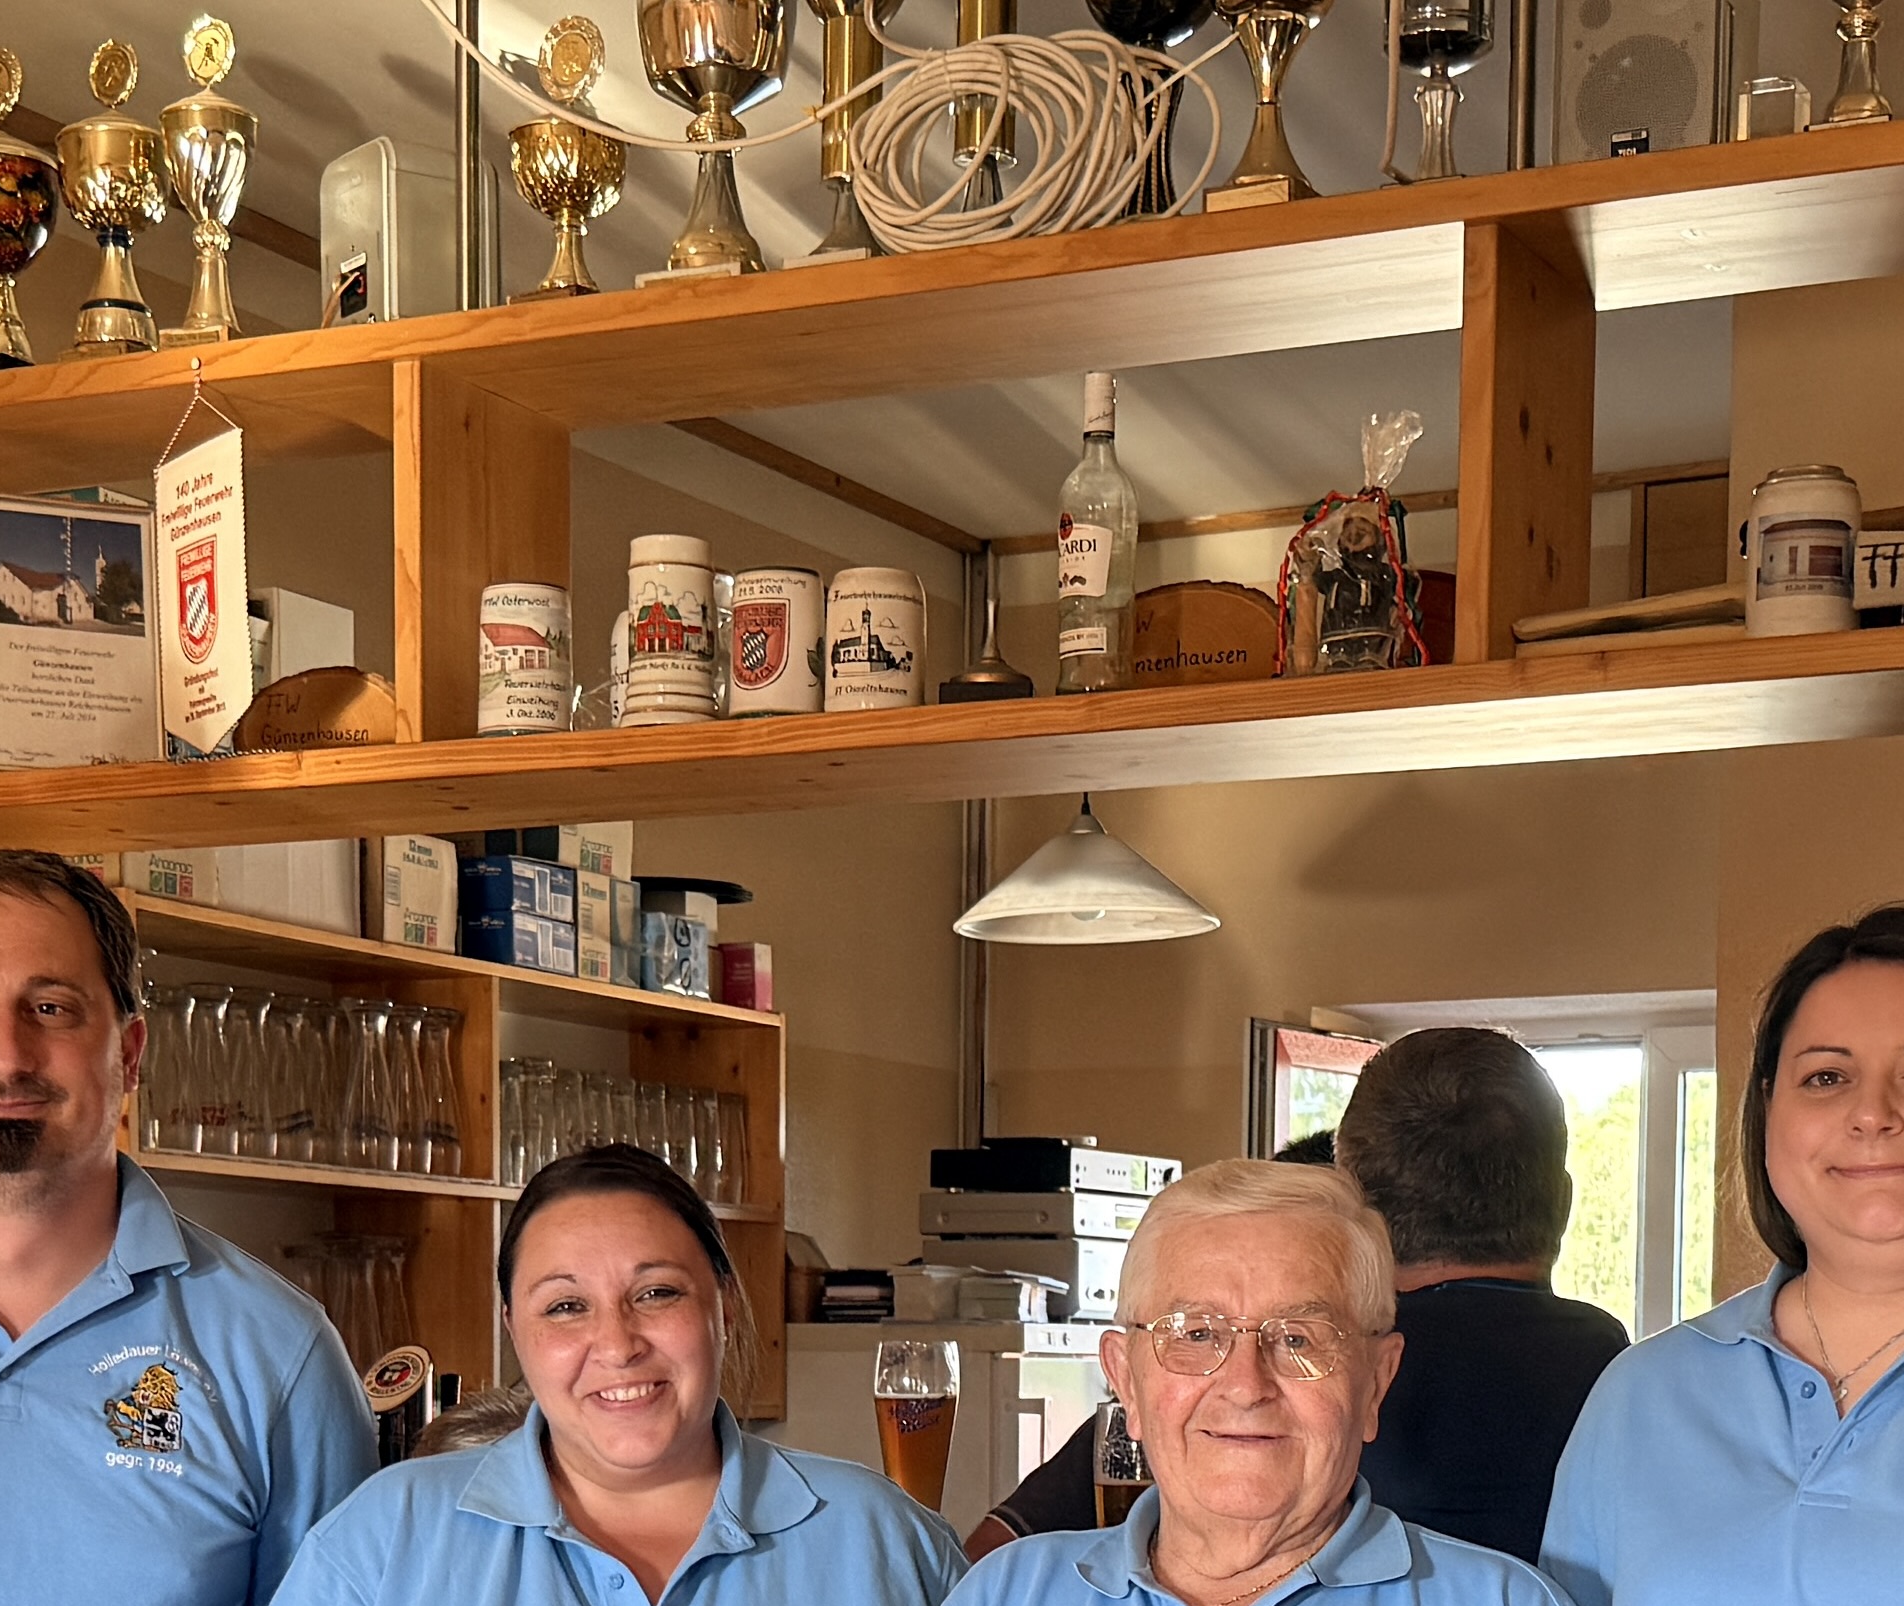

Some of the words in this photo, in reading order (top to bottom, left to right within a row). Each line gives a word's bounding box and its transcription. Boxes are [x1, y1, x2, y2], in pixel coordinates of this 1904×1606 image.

[33, 659, 93, 672] Günzenhausen
[261, 720, 369, 745] Günzenhausen
[88, 1344, 160, 1377] Holledauer
[105, 1451, 143, 1469] gegr.
[149, 1456, 184, 1477] 1994
